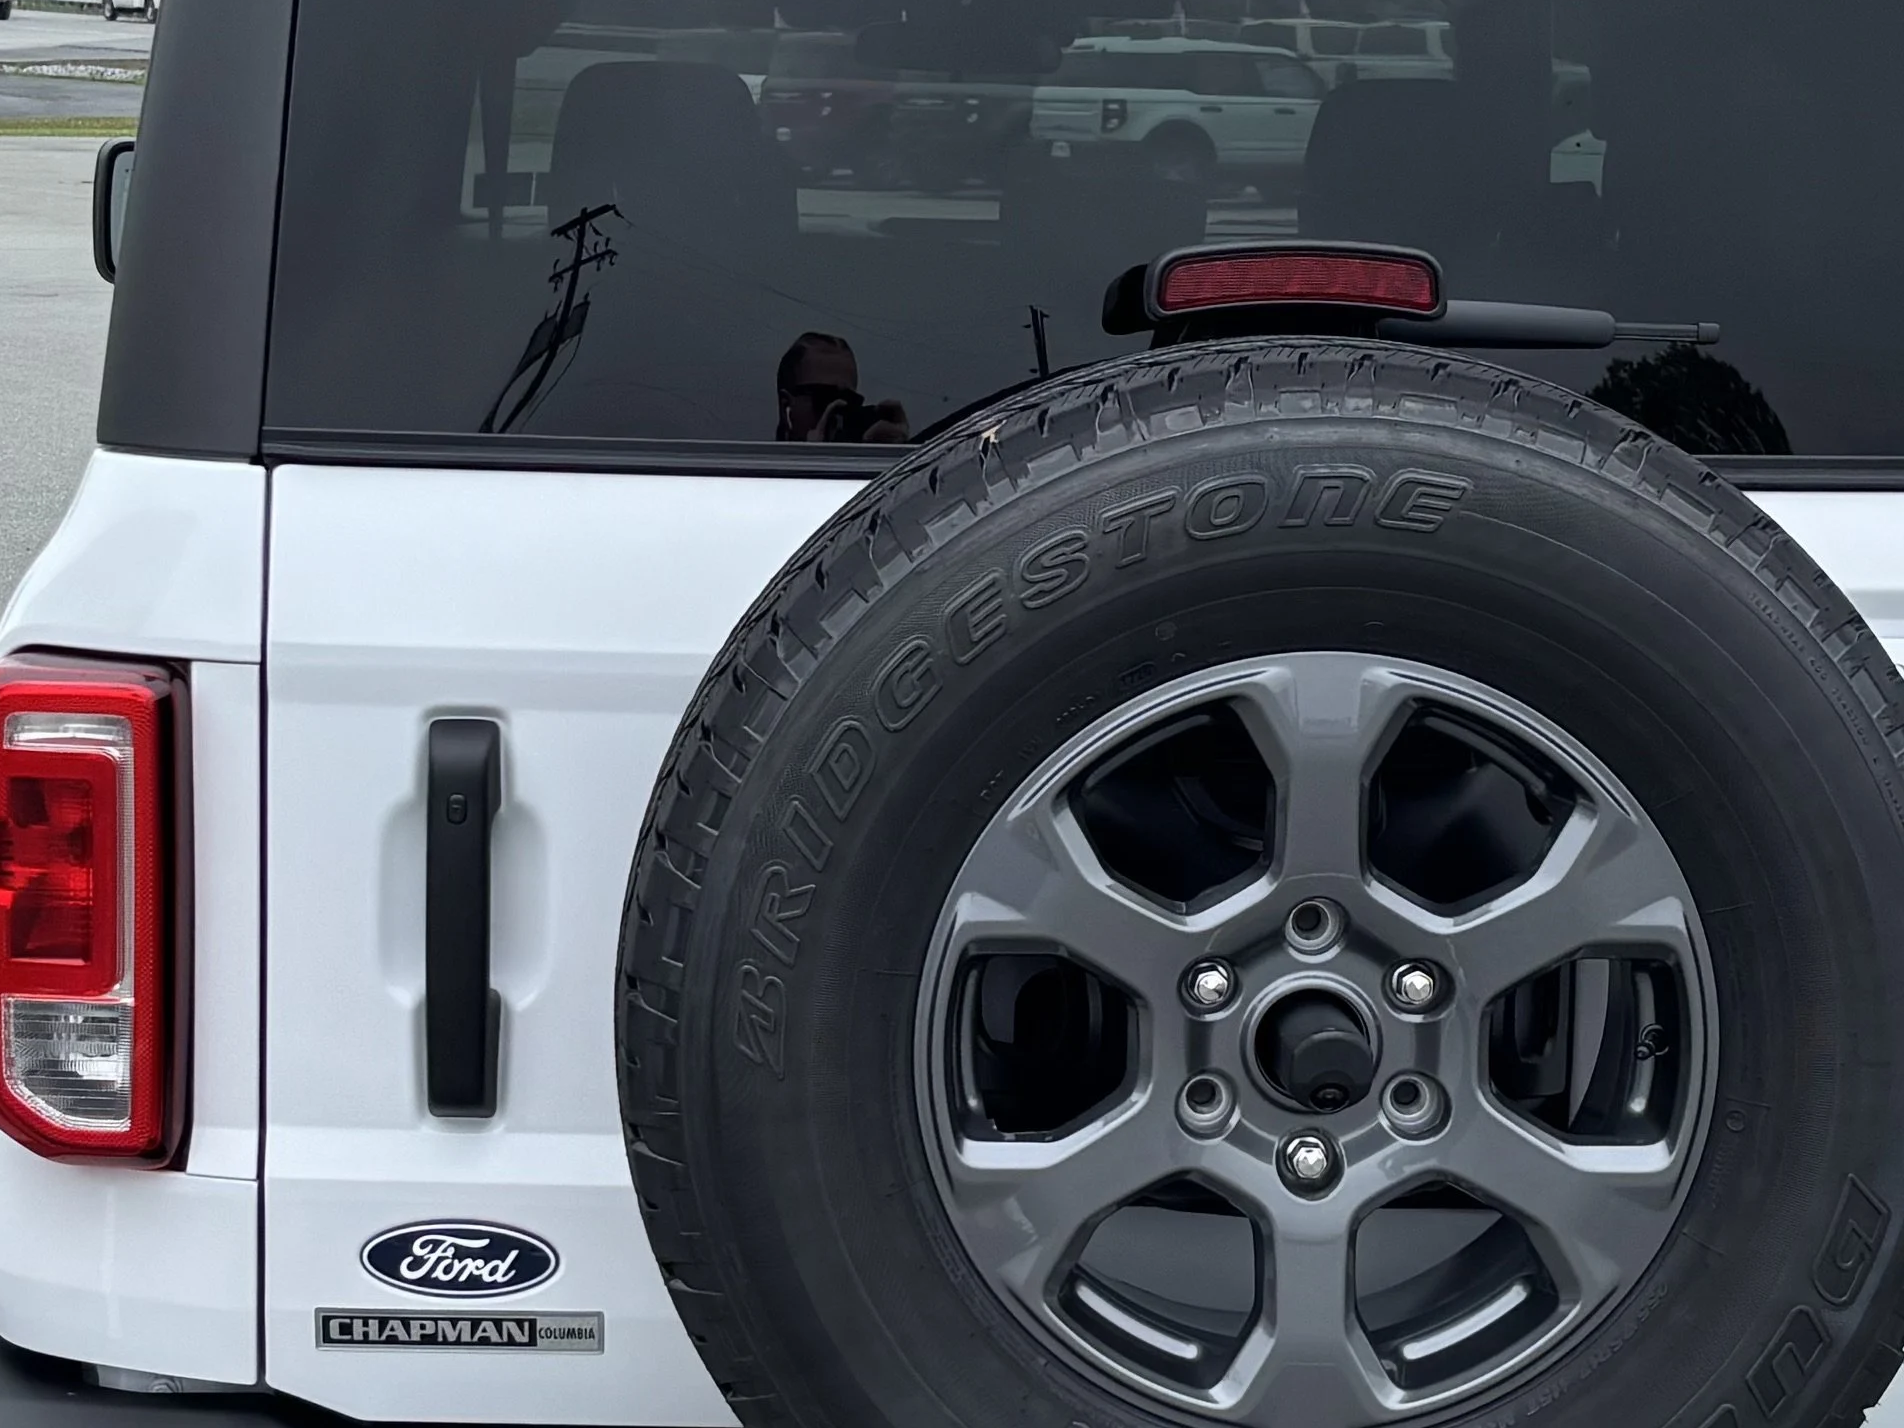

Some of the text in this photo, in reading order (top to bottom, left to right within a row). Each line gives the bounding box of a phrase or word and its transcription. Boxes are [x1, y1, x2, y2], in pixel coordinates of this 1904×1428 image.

[732, 464, 1473, 1080] BRIDGESTONE
[399, 1234, 520, 1284] Ford
[329, 1318, 596, 1343] CHAPMAN COLUMBIA
